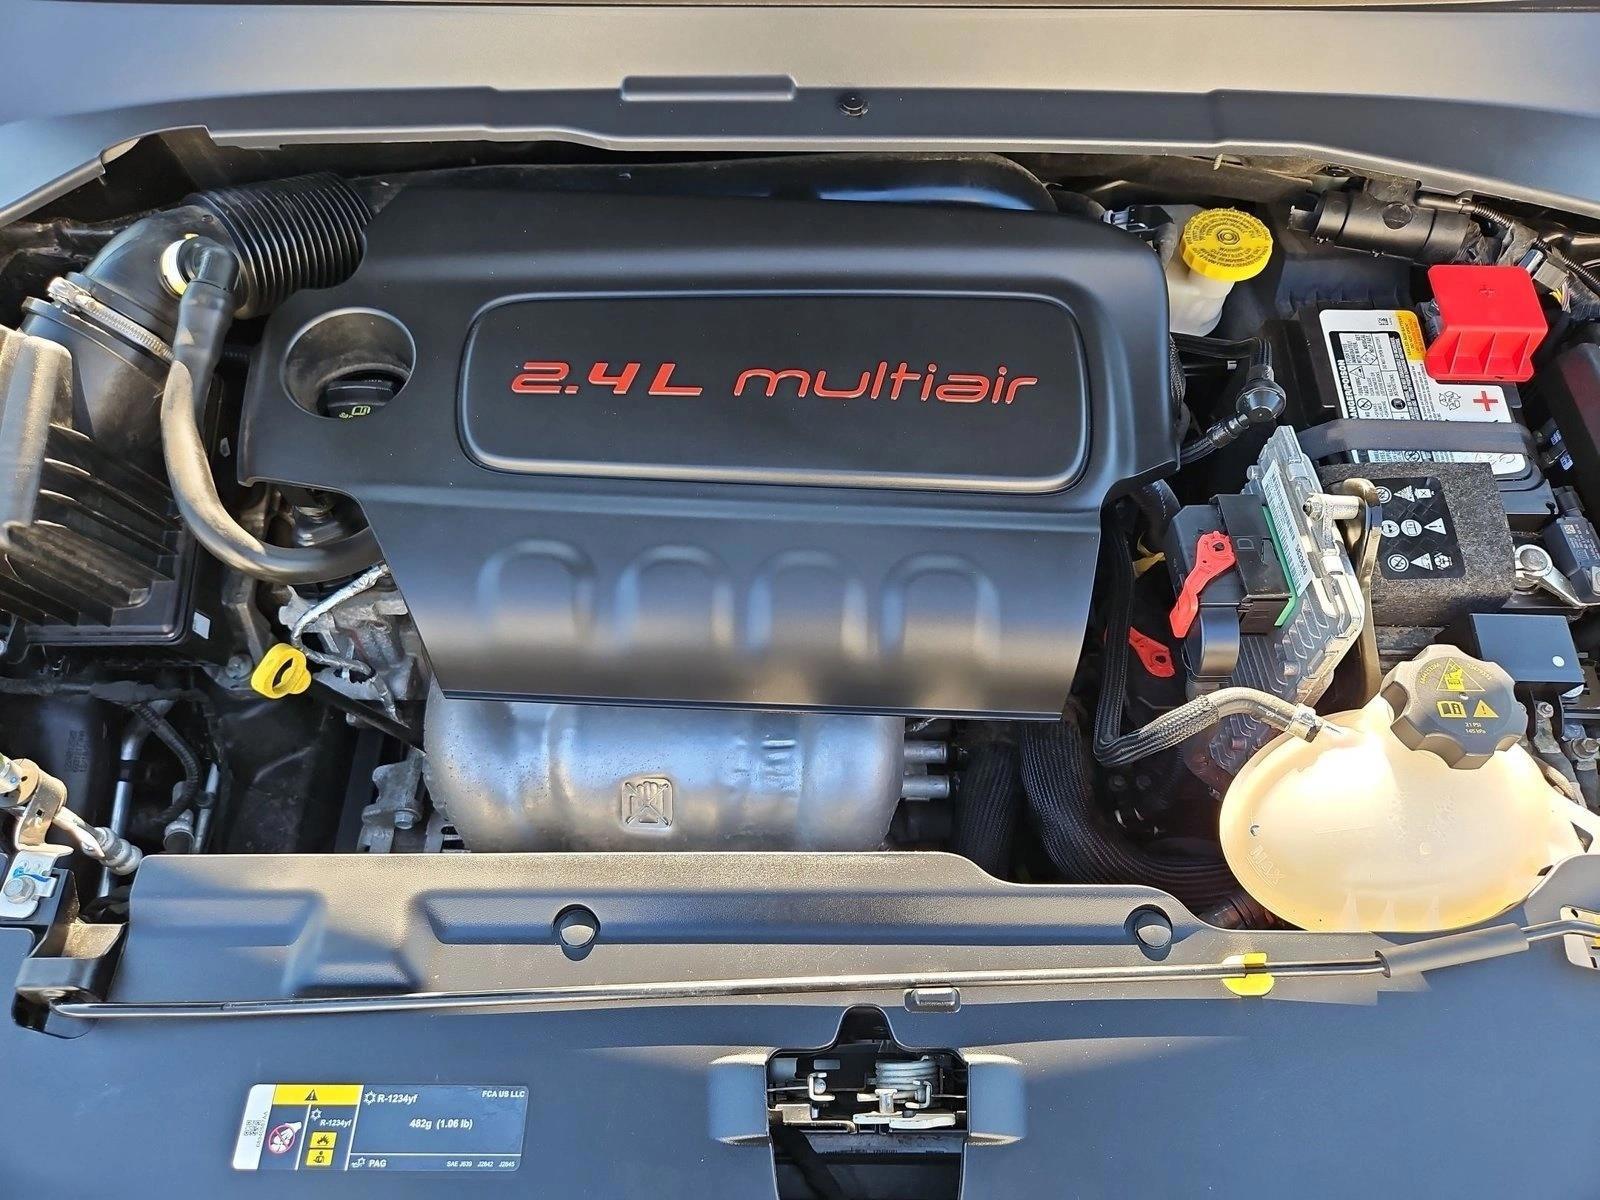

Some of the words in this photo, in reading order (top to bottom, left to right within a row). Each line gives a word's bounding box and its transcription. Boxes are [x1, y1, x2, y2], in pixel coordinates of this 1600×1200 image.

[733, 360, 1039, 405] multiair
[481, 1090, 498, 1098] FCA
[498, 1090, 510, 1098] US
[510, 1090, 526, 1098] LLC
[376, 1093, 419, 1106] R-1234yf
[320, 1119, 353, 1128] R-1234yf
[409, 1118, 433, 1131] 482g
[436, 1118, 460, 1131] (1.06
[460, 1118, 474, 1130] lb)
[368, 1159, 387, 1168] PAG
[446, 1160, 459, 1168] SAE
